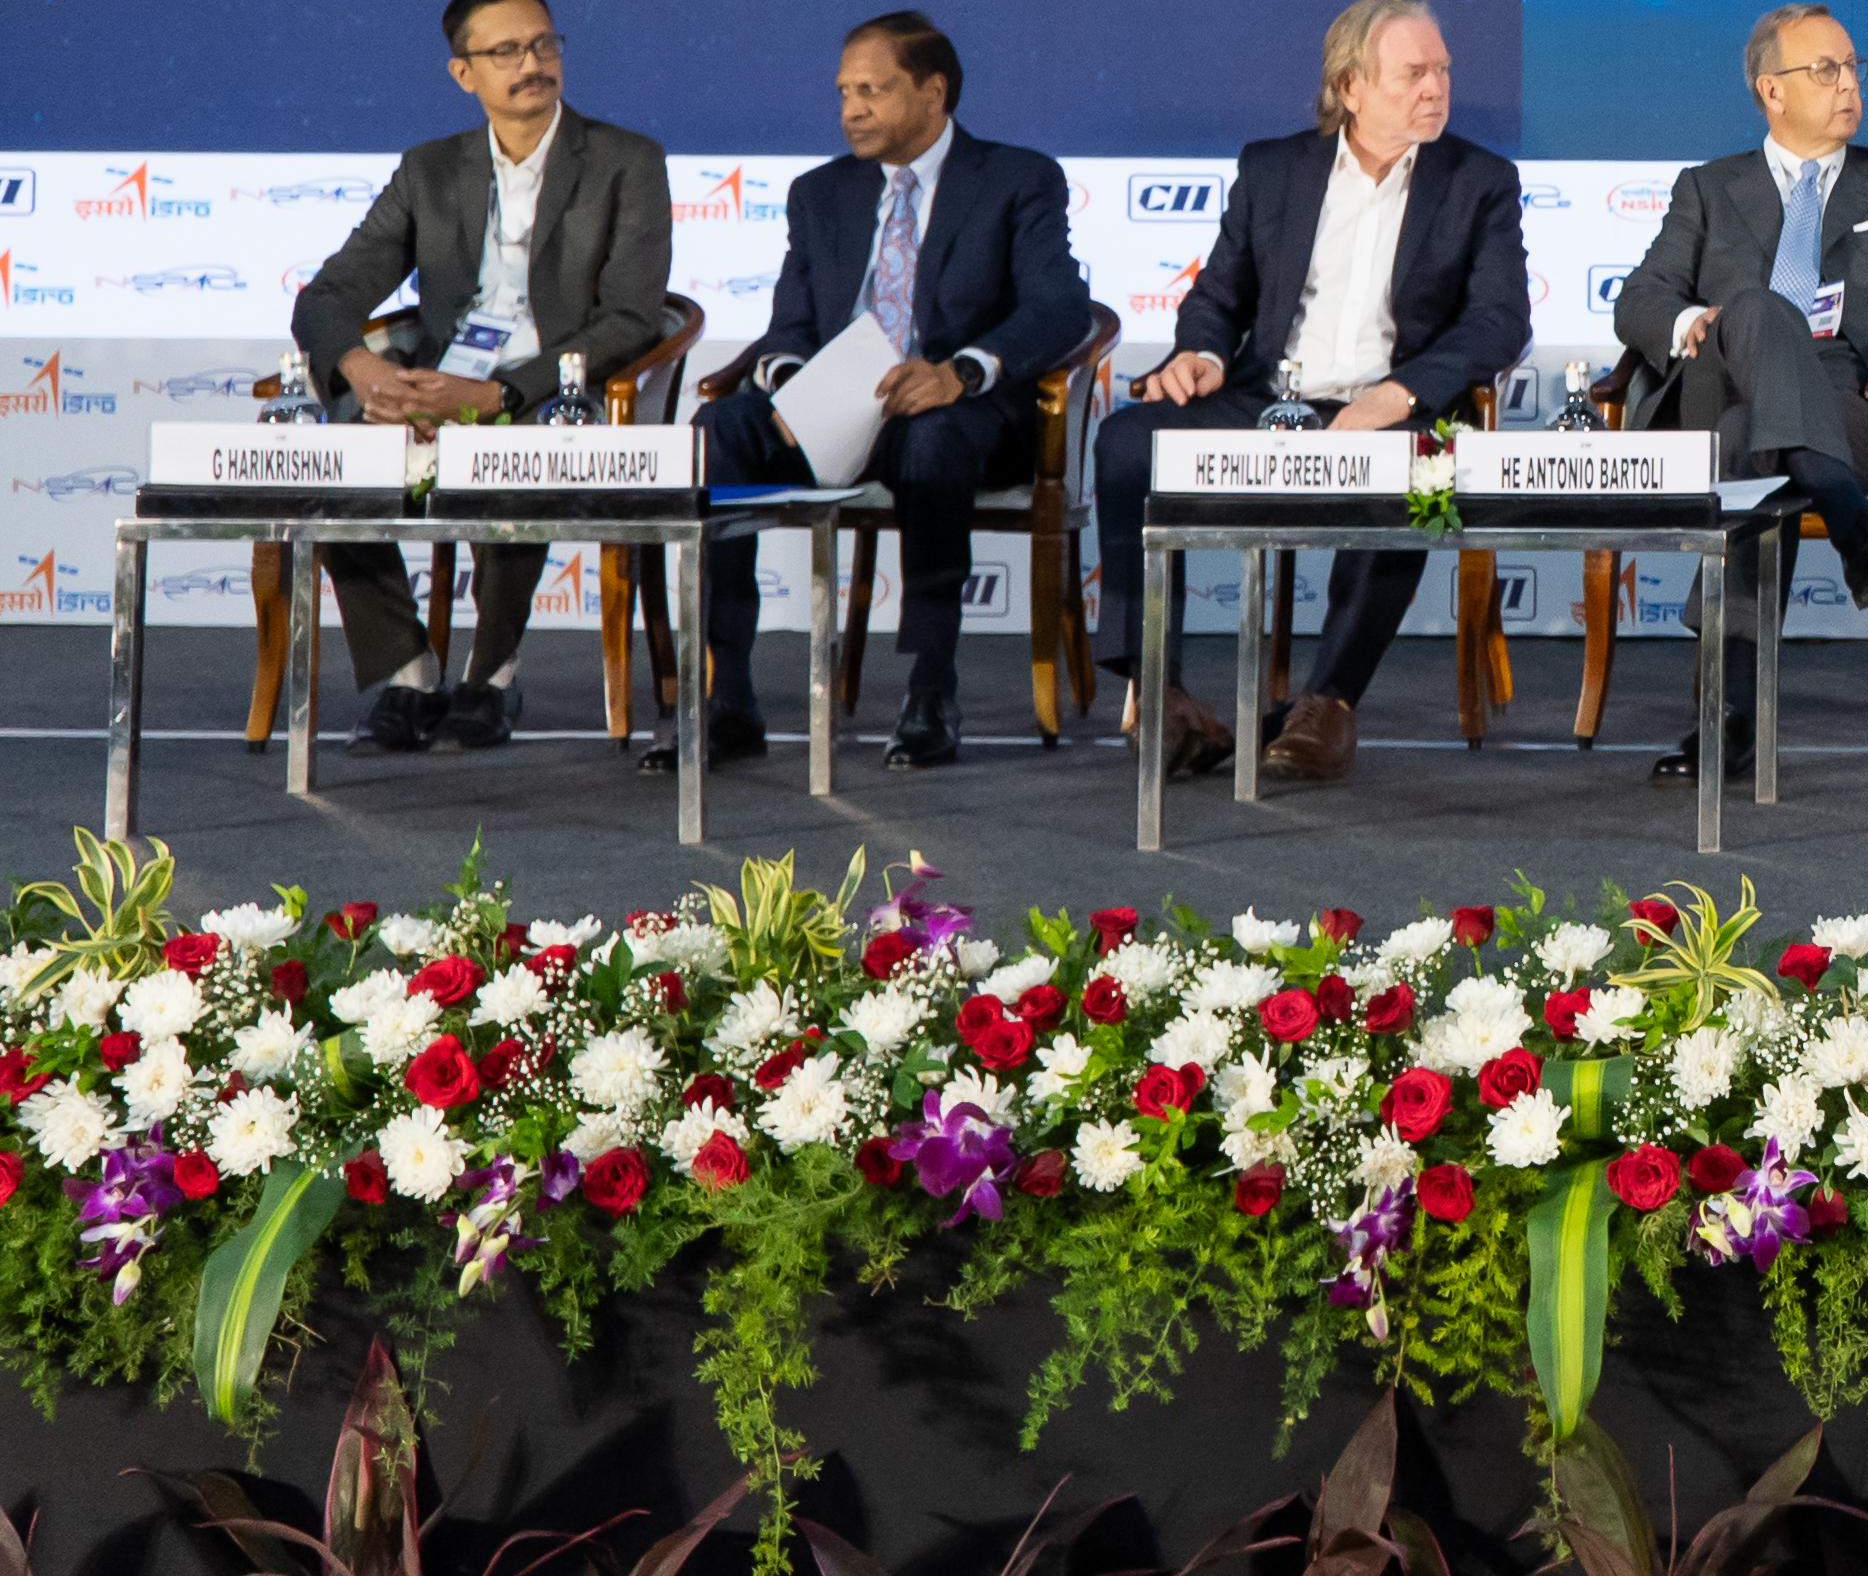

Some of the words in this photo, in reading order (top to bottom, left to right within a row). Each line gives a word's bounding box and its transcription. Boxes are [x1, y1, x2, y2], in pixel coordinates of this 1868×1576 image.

[1139, 185, 1213, 212] CII
[213, 448, 223, 481] G
[228, 449, 343, 482] HARIKRISHNAN
[471, 451, 541, 483] APPARAO
[548, 451, 658, 483] MALLAVARAPU
[1196, 453, 1216, 486] HE
[1221, 454, 1277, 486] PHILLIP
[1282, 454, 1332, 487] GREEN
[1338, 455, 1371, 488] OAM
[1501, 457, 1521, 489] HE
[1526, 457, 1594, 490] ANTONIO
[1600, 457, 1663, 490] BARTOLI
